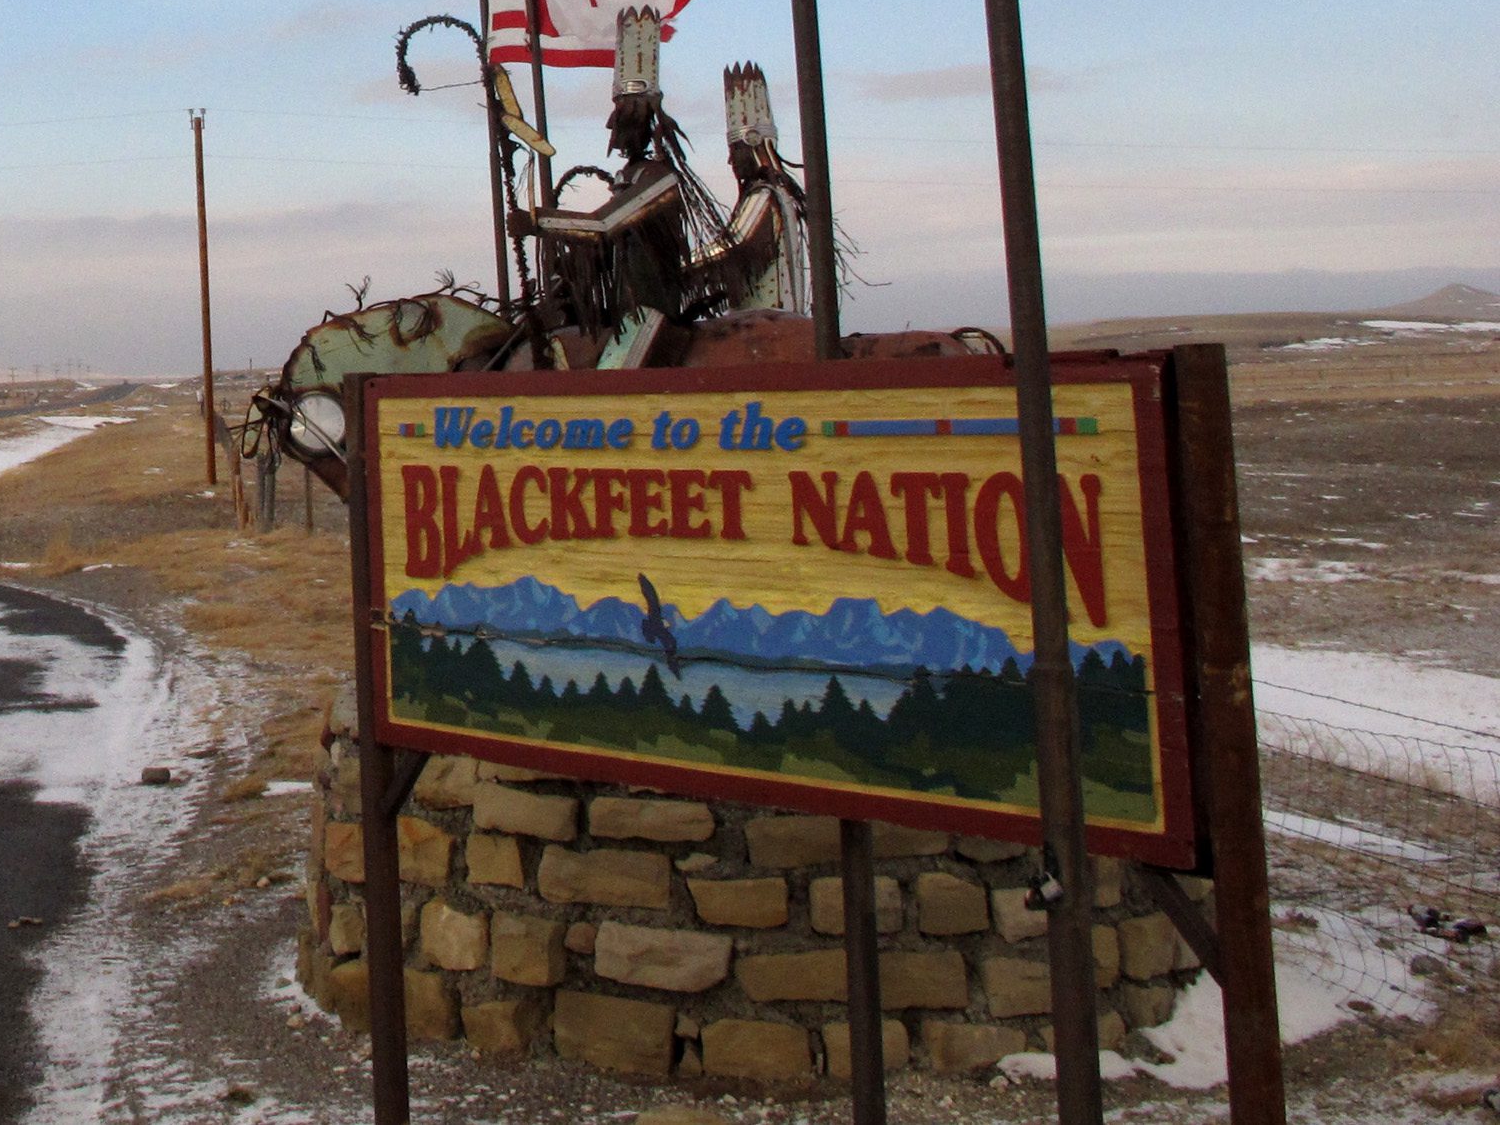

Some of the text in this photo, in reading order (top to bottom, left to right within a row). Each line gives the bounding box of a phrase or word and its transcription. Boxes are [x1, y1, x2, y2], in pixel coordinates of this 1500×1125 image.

[433, 401, 808, 452] Welcome to the
[401, 463, 1108, 628] BLACKFEET NATION
